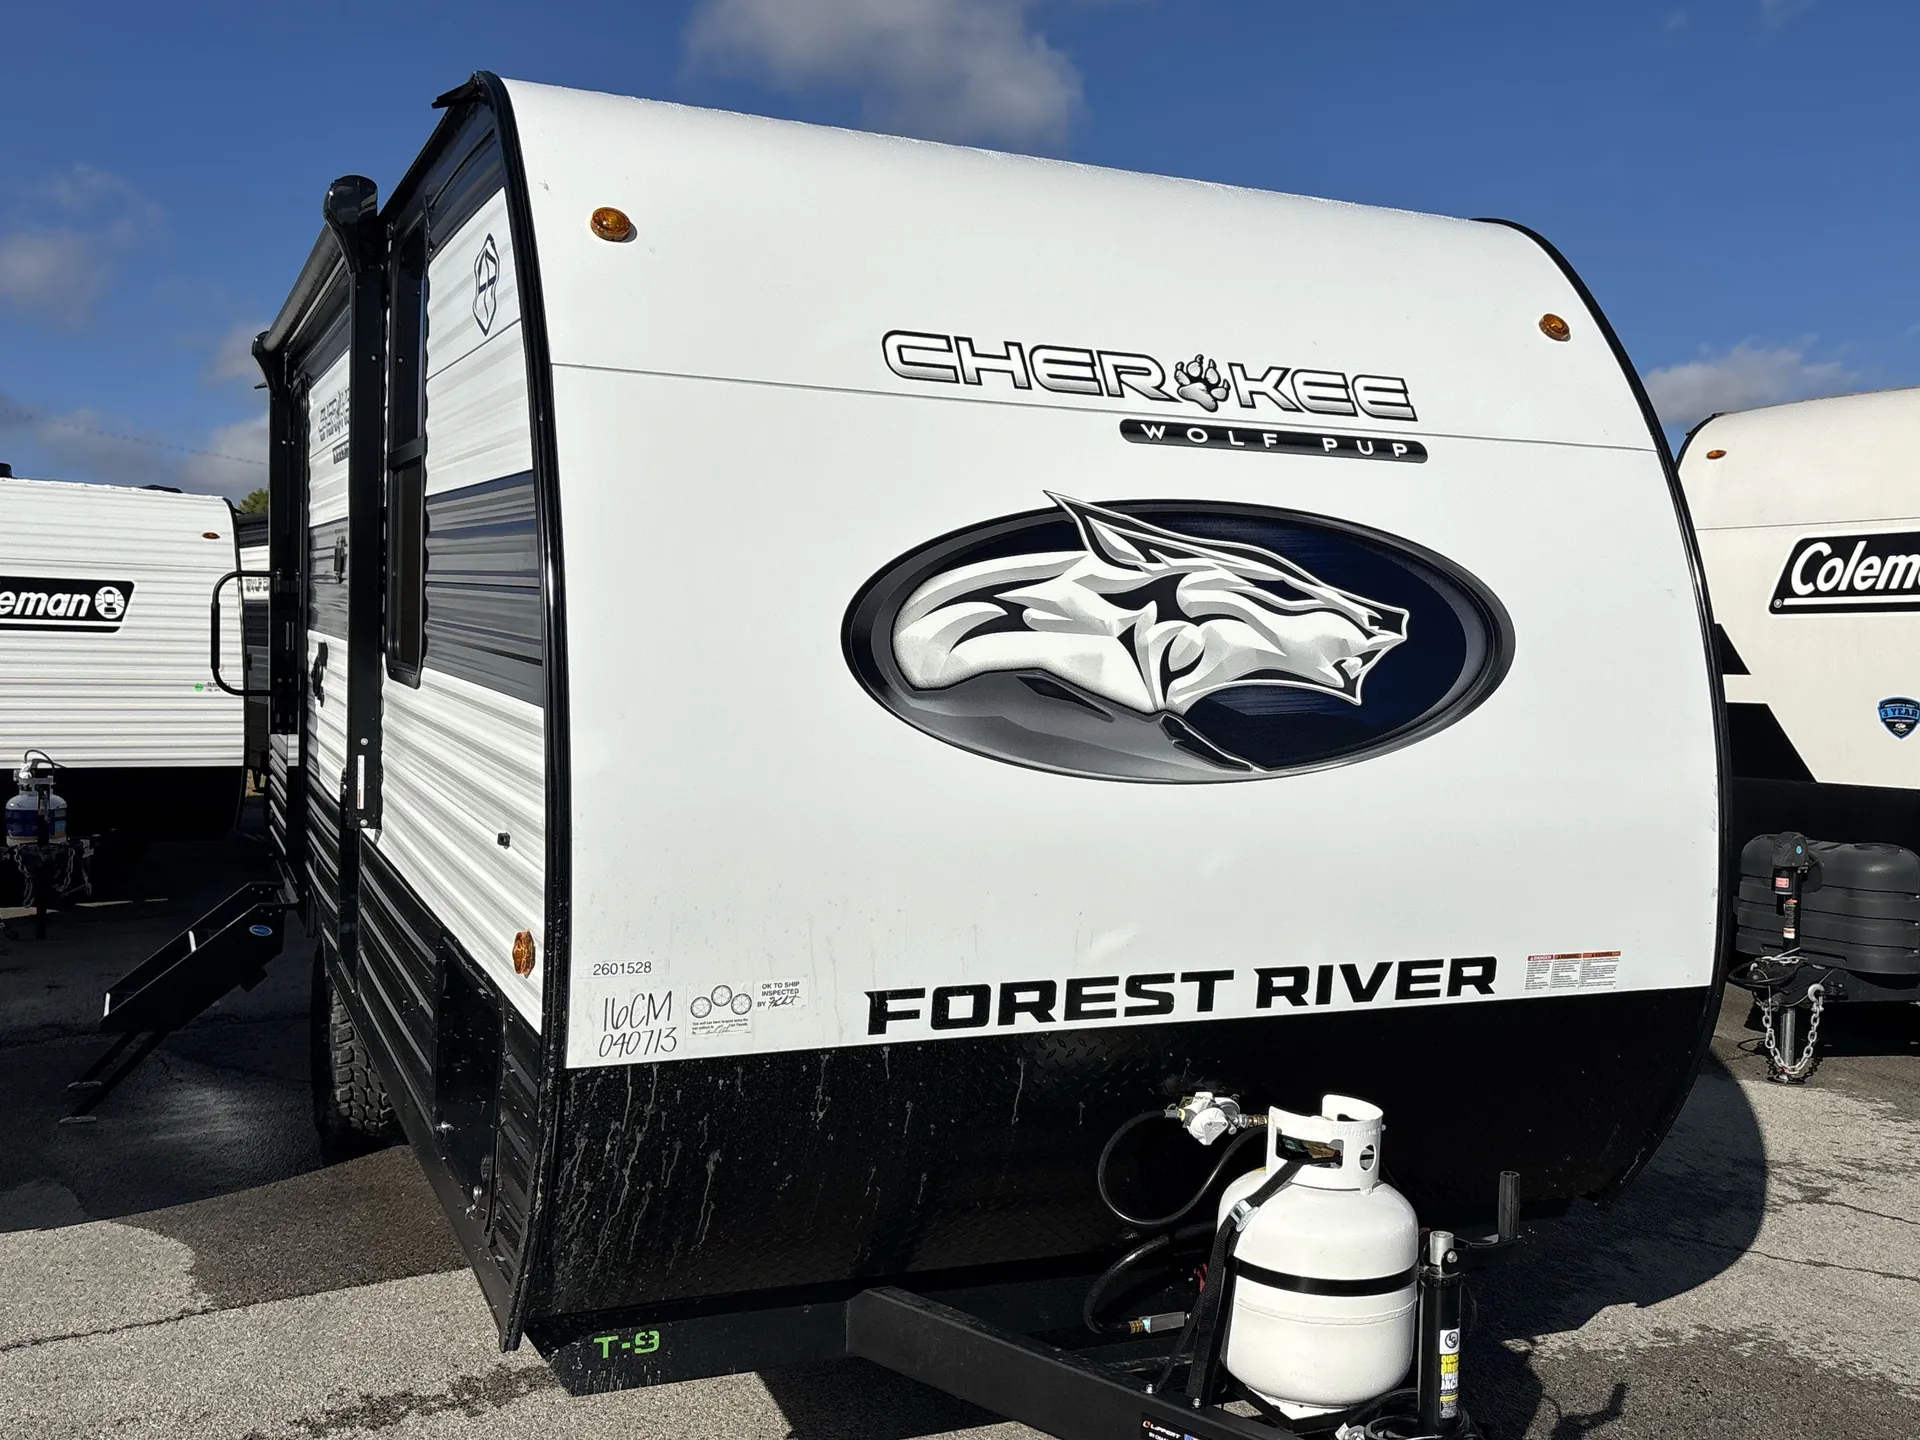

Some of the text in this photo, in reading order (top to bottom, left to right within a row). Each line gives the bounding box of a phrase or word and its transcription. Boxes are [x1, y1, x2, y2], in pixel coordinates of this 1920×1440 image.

[1140, 423, 1408, 459] WOLF PUP
[1791, 540, 1920, 596] Colem
[592, 961, 652, 976] 2601528
[761, 988, 800, 997] INSPECTED
[864, 969, 1234, 1036] FOREST
[1253, 956, 1498, 1009] RIVER
[603, 990, 673, 1032] 16CM
[599, 1026, 678, 1058] 040713
[593, 1330, 660, 1359] T-9
